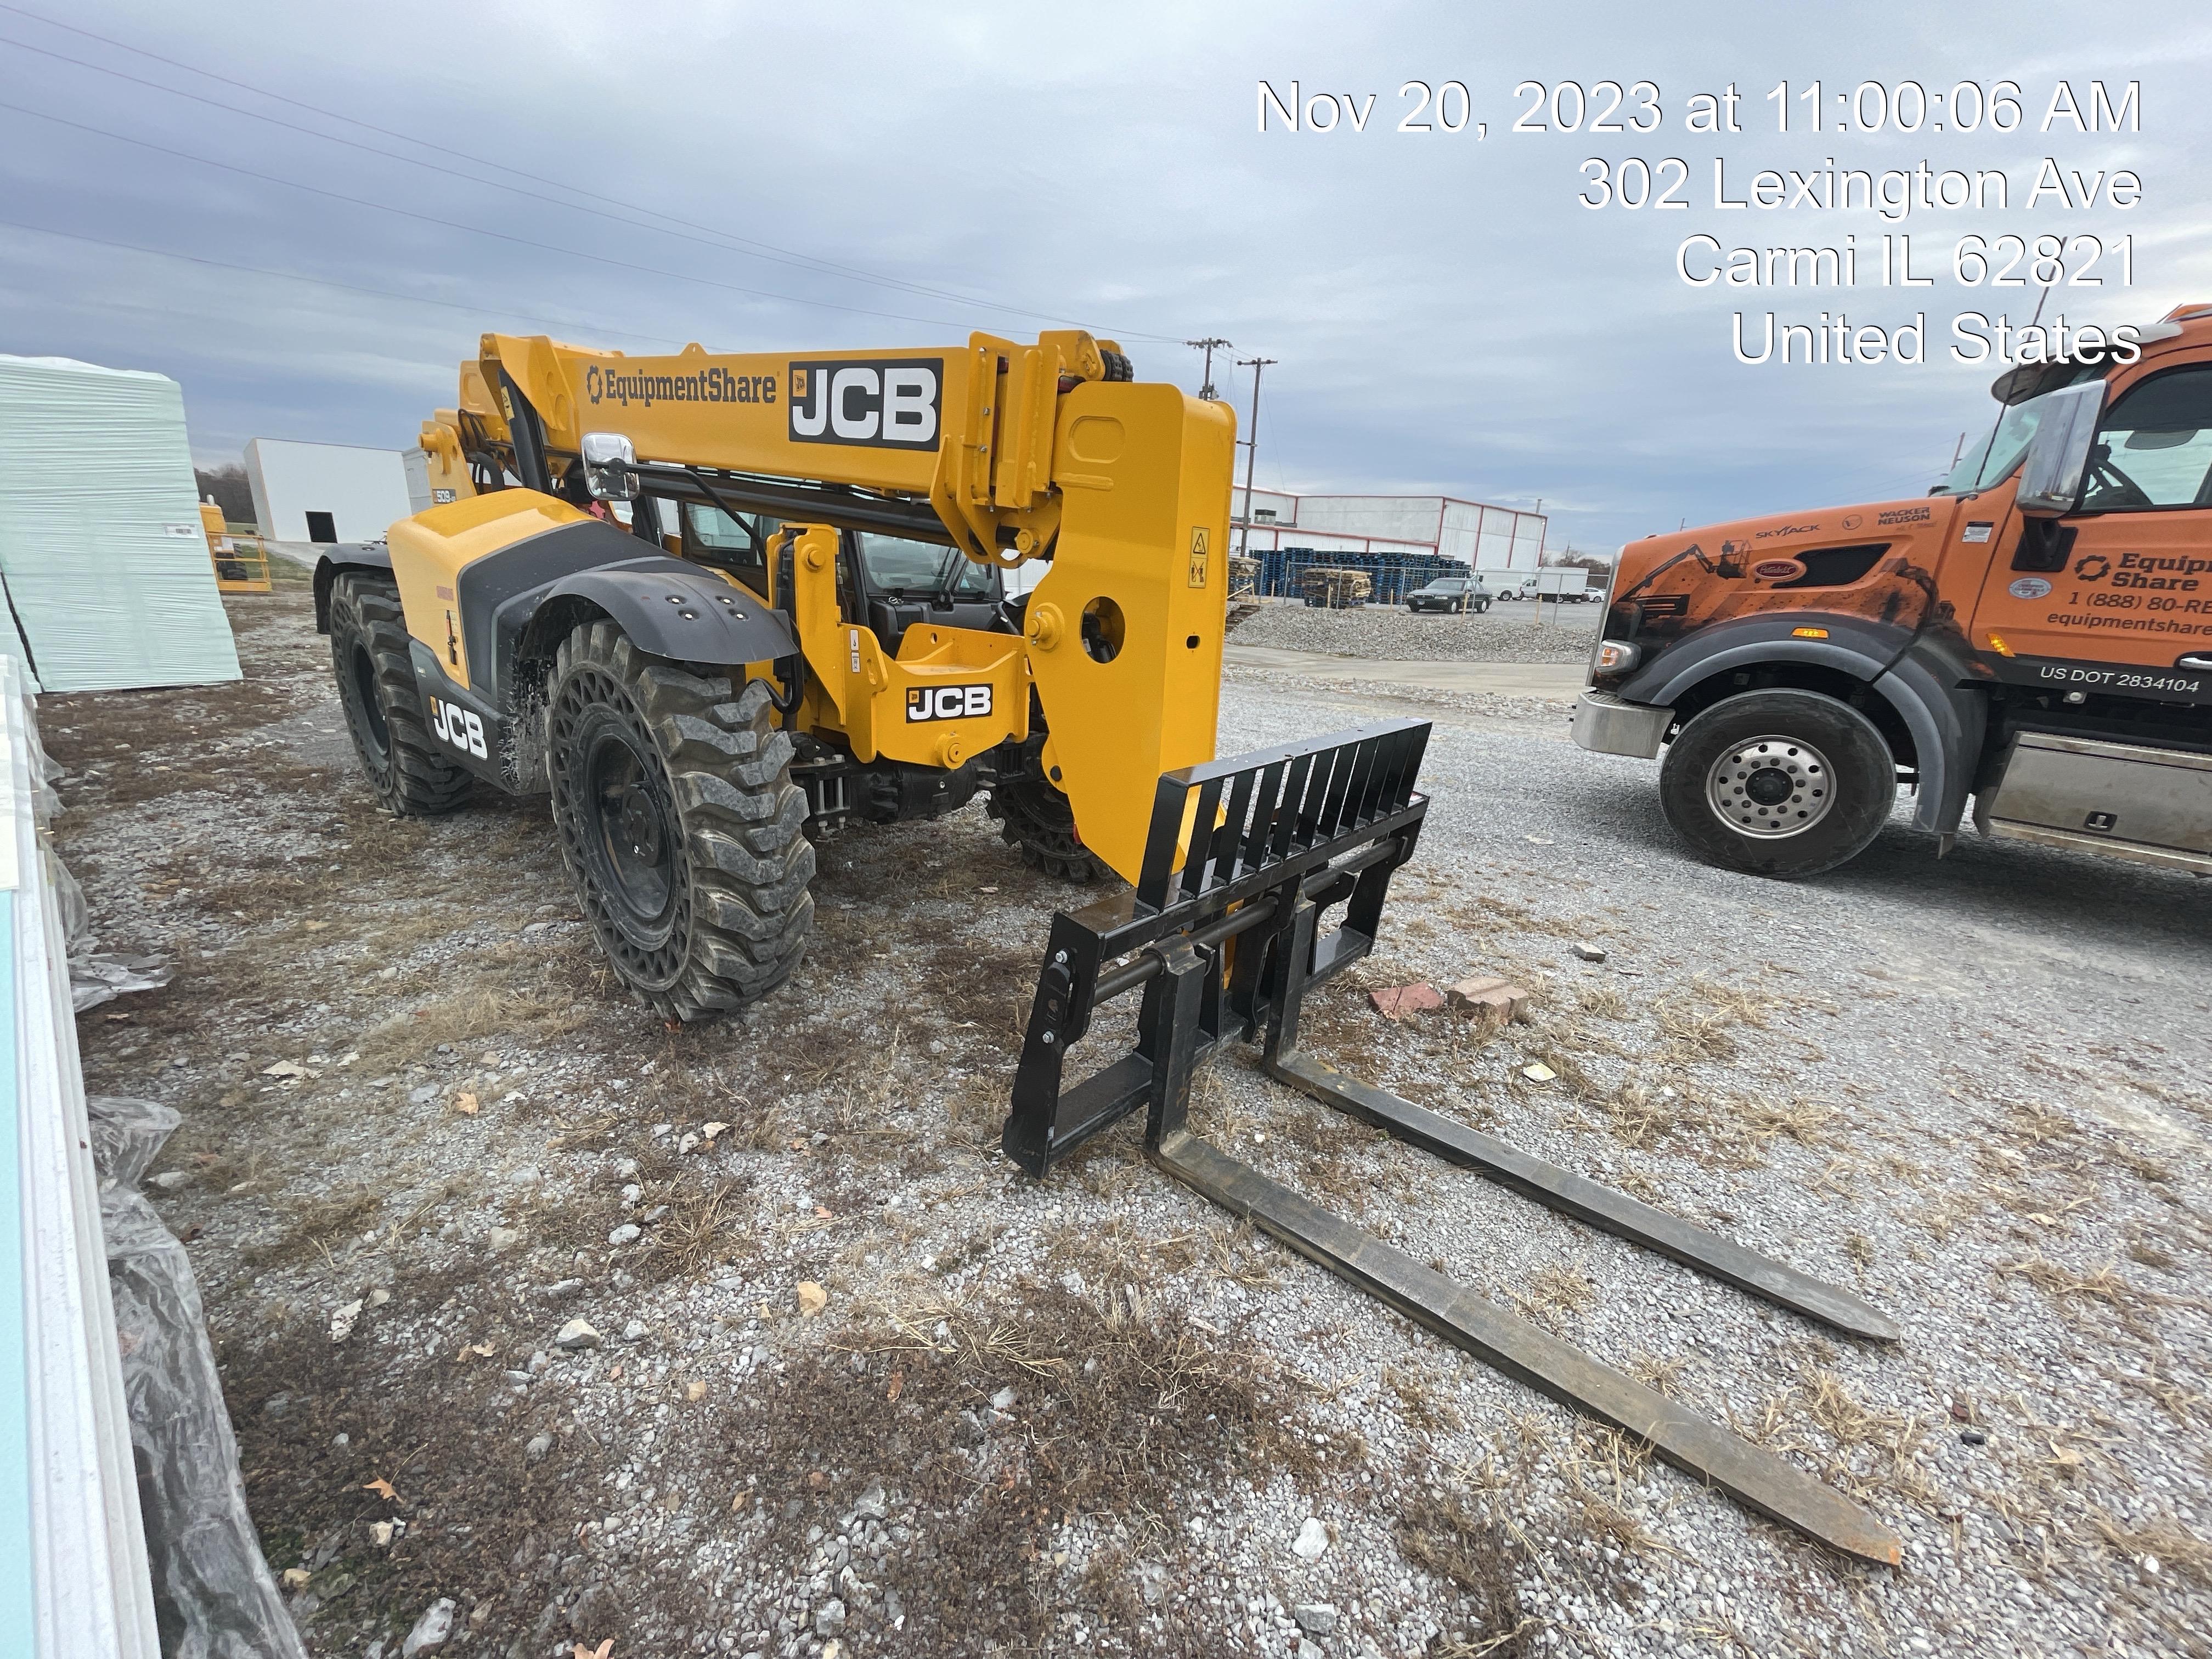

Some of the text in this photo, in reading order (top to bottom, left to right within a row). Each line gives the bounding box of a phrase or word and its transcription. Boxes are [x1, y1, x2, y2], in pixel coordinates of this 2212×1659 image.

[605, 368, 937, 442] EquipmentShare JCB
[1878, 507, 1929, 517] WACKER
[1878, 514, 1930, 525] NEUSON
[1756, 523, 1820, 539] SKYJACK
[2111, 572, 2199, 591] Share
[2068, 591, 2079, 605] 1
[2086, 592, 2142, 610] (888)
[2040, 667, 2199, 692] US DOT 2834104
[909, 687, 991, 720] JCB
[433, 699, 488, 760] JCB
